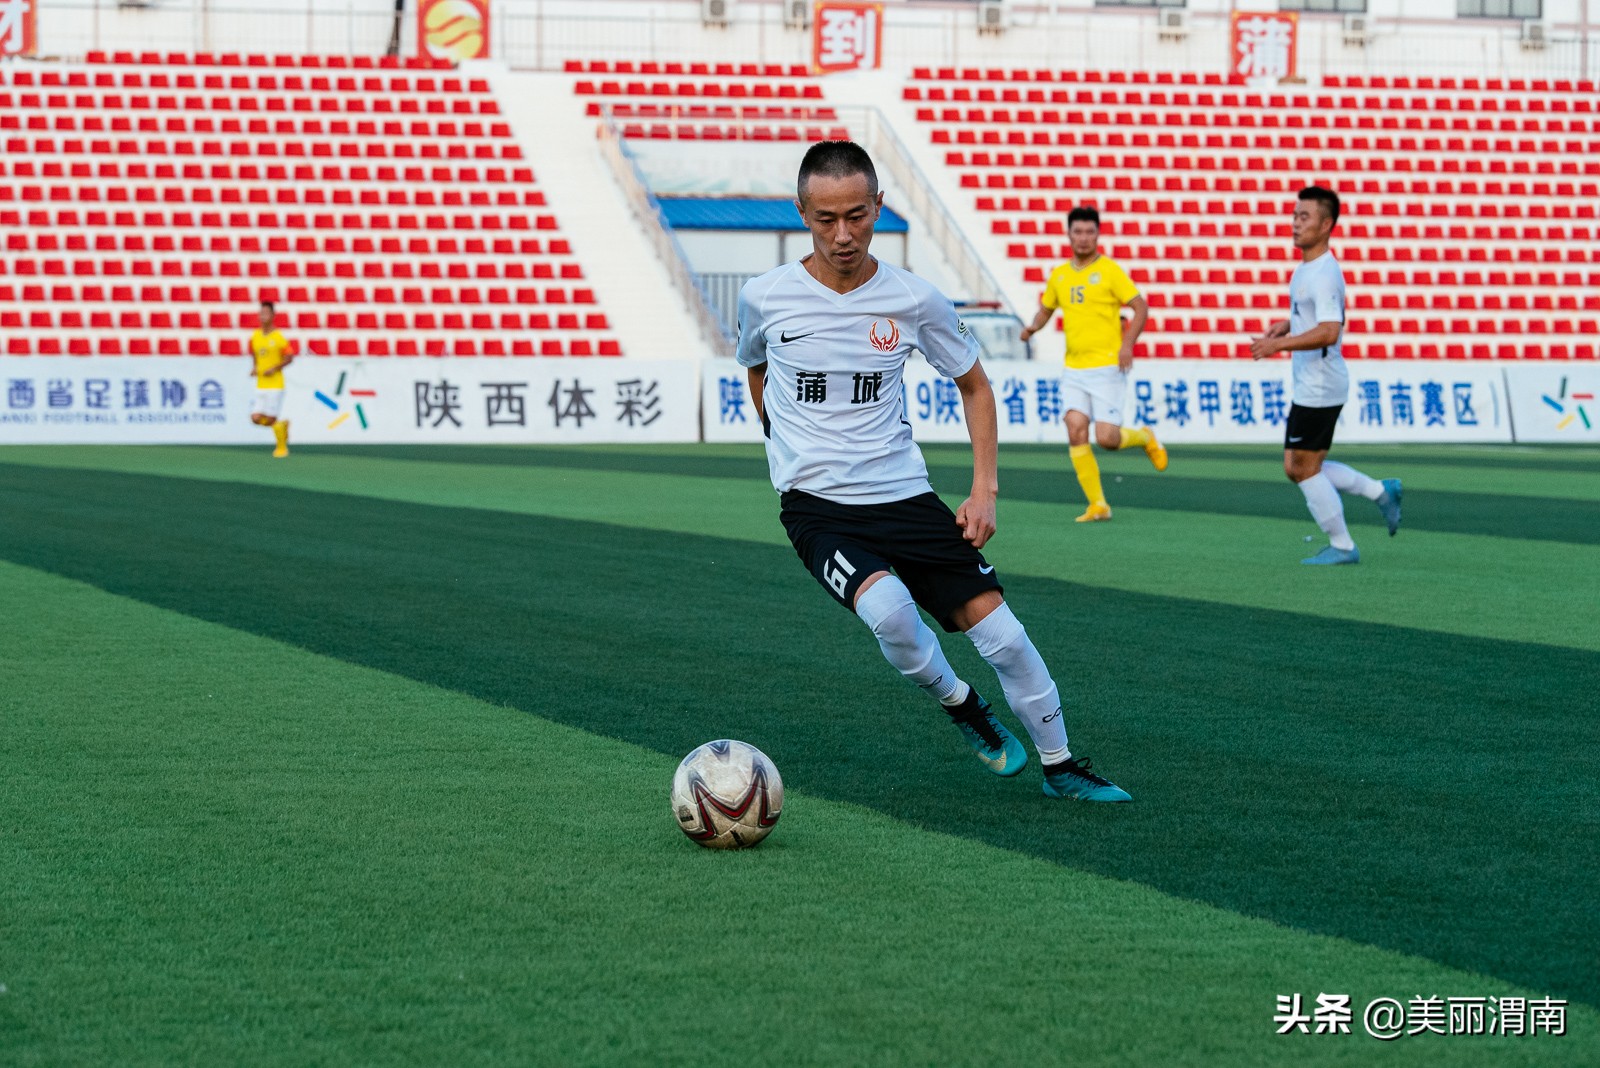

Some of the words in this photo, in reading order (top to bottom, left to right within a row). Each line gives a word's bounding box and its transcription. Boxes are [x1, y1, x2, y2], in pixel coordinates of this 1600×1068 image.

[821, 8, 876, 70] 到
[1237, 16, 1292, 78] 蒲
[1069, 285, 1086, 304] 15
[8, 378, 225, 409] 西省足球协会
[414, 379, 662, 428] 陕西体彩
[796, 372, 883, 404] 蒲城
[823, 549, 857, 599] 61
